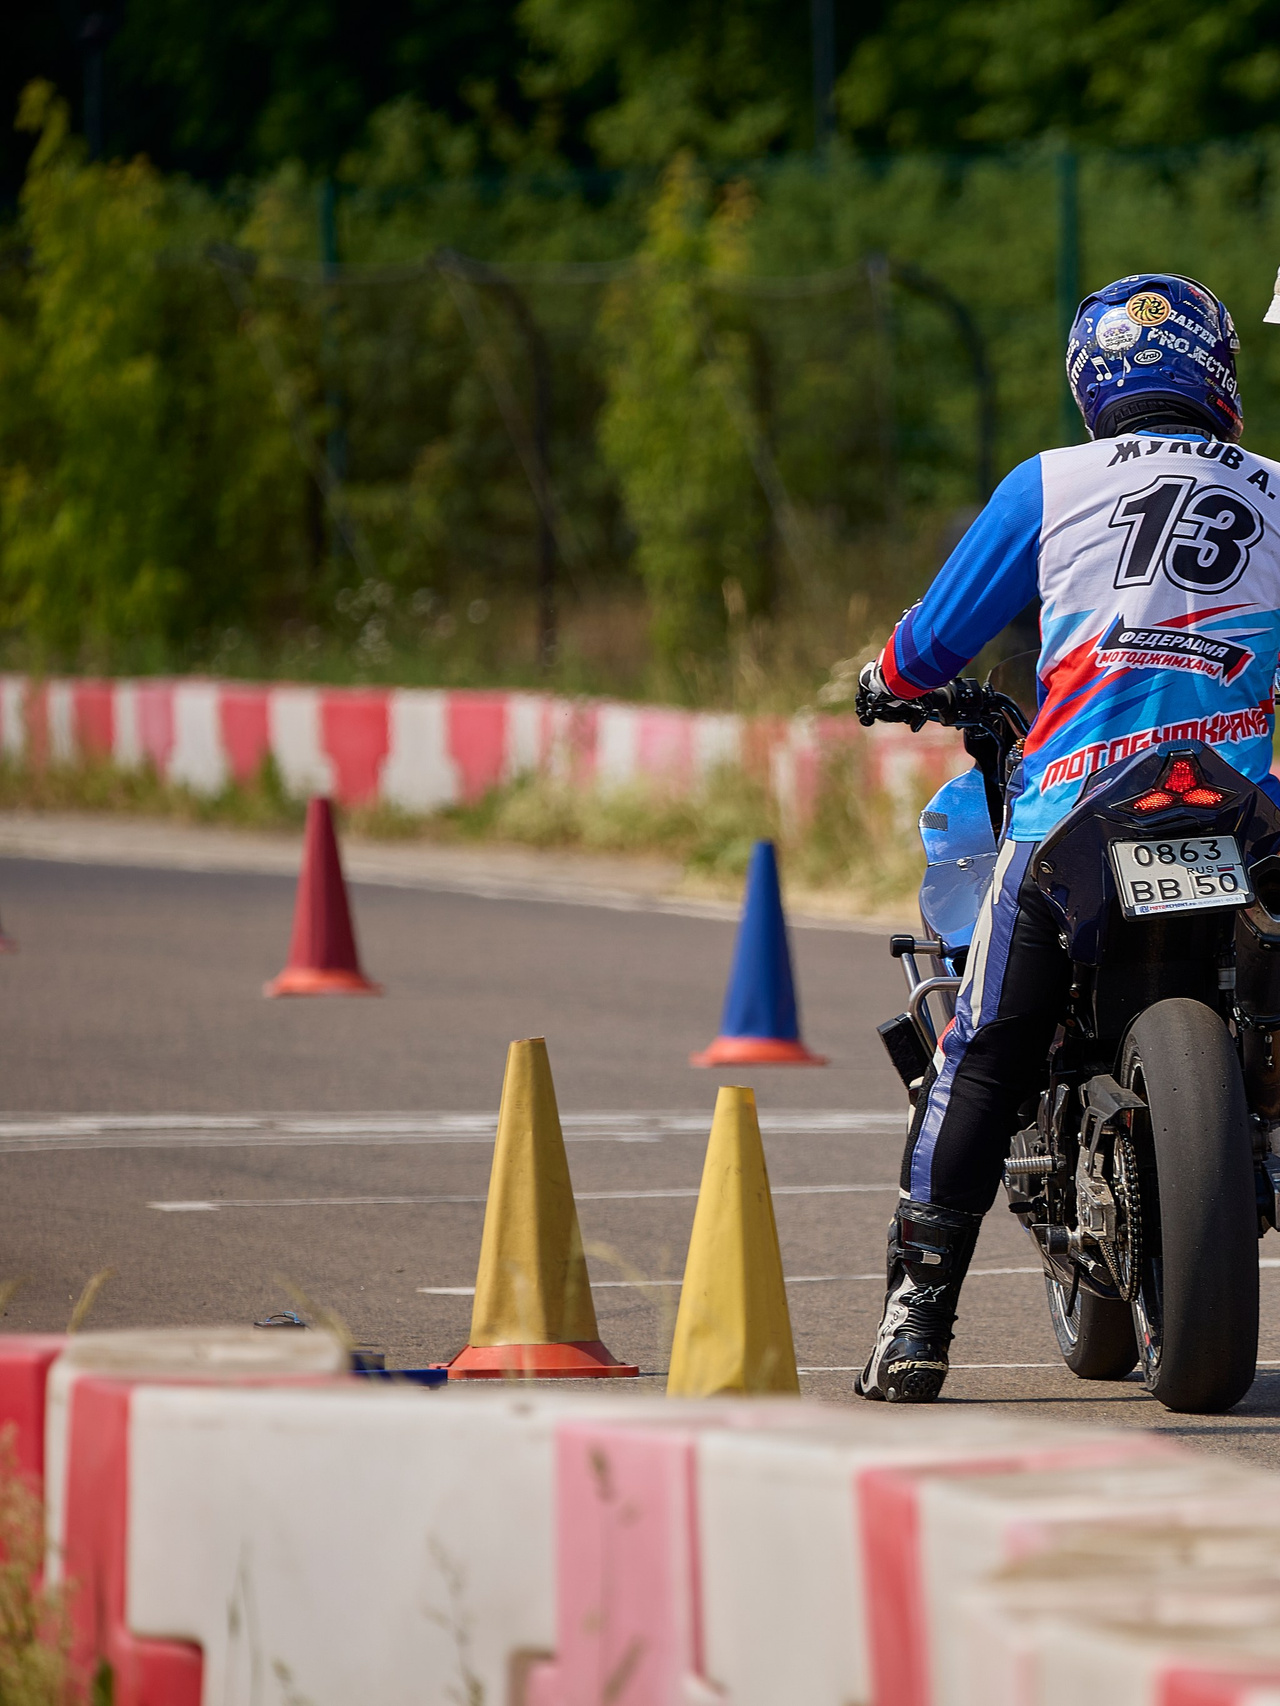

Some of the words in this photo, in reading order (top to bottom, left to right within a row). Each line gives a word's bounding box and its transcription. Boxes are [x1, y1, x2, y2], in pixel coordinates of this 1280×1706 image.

[1138, 298, 1163, 315] 13
[1168, 309, 1217, 348] GALFER
[1138, 351, 1160, 361] Arai
[1246, 468, 1277, 500] А.
[1108, 474, 1265, 595] 13
[1118, 631, 1229, 658] ФЕДЕРАЦИЯ
[1133, 840, 1222, 867] 0863
[1187, 865, 1214, 875] RUS
[1195, 872, 1238, 896] 50
